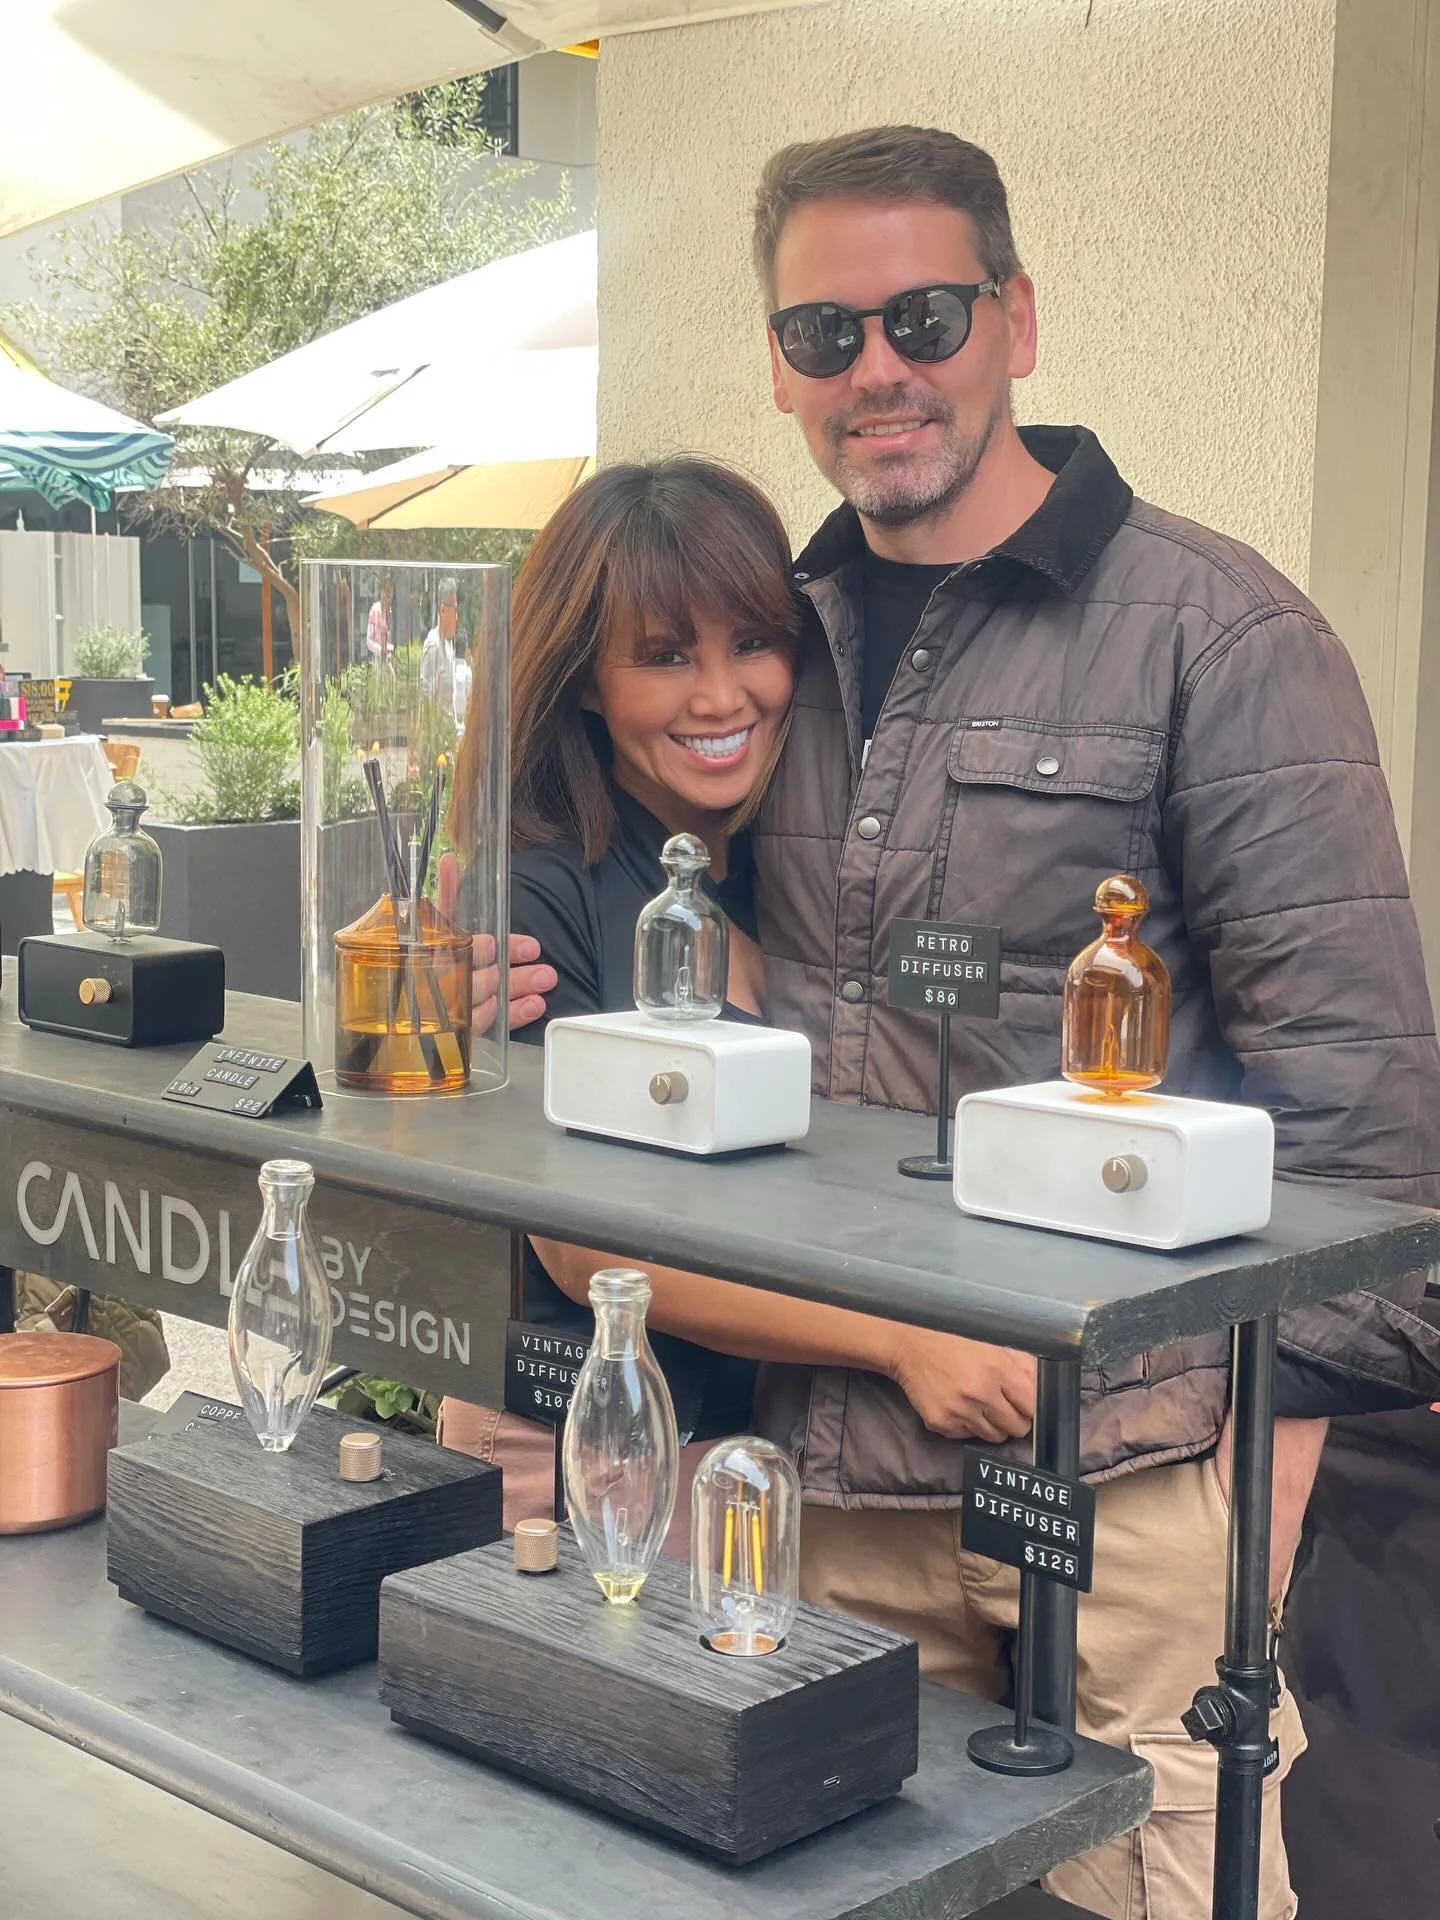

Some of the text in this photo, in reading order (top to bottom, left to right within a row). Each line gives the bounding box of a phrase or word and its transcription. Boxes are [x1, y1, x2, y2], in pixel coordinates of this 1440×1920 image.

[917, 935, 969, 953] RETRO
[900, 960, 984, 979] DIFFUSER
[924, 988, 956, 1006] $80
[216, 1048, 283, 1069] INFINITE
[206, 1068, 255, 1087] CANDLE
[235, 1097, 262, 1112] $22
[320, 1235, 372, 1287] BY
[326, 1288, 470, 1365] DESIGN
[517, 1359, 579, 1385] DIFFUS
[200, 1404, 244, 1421] COPPE
[979, 1463, 1069, 1507] VINTAGE
[975, 1492, 1076, 1542] DIFFUSER
[1024, 1545, 1075, 1576] $125
